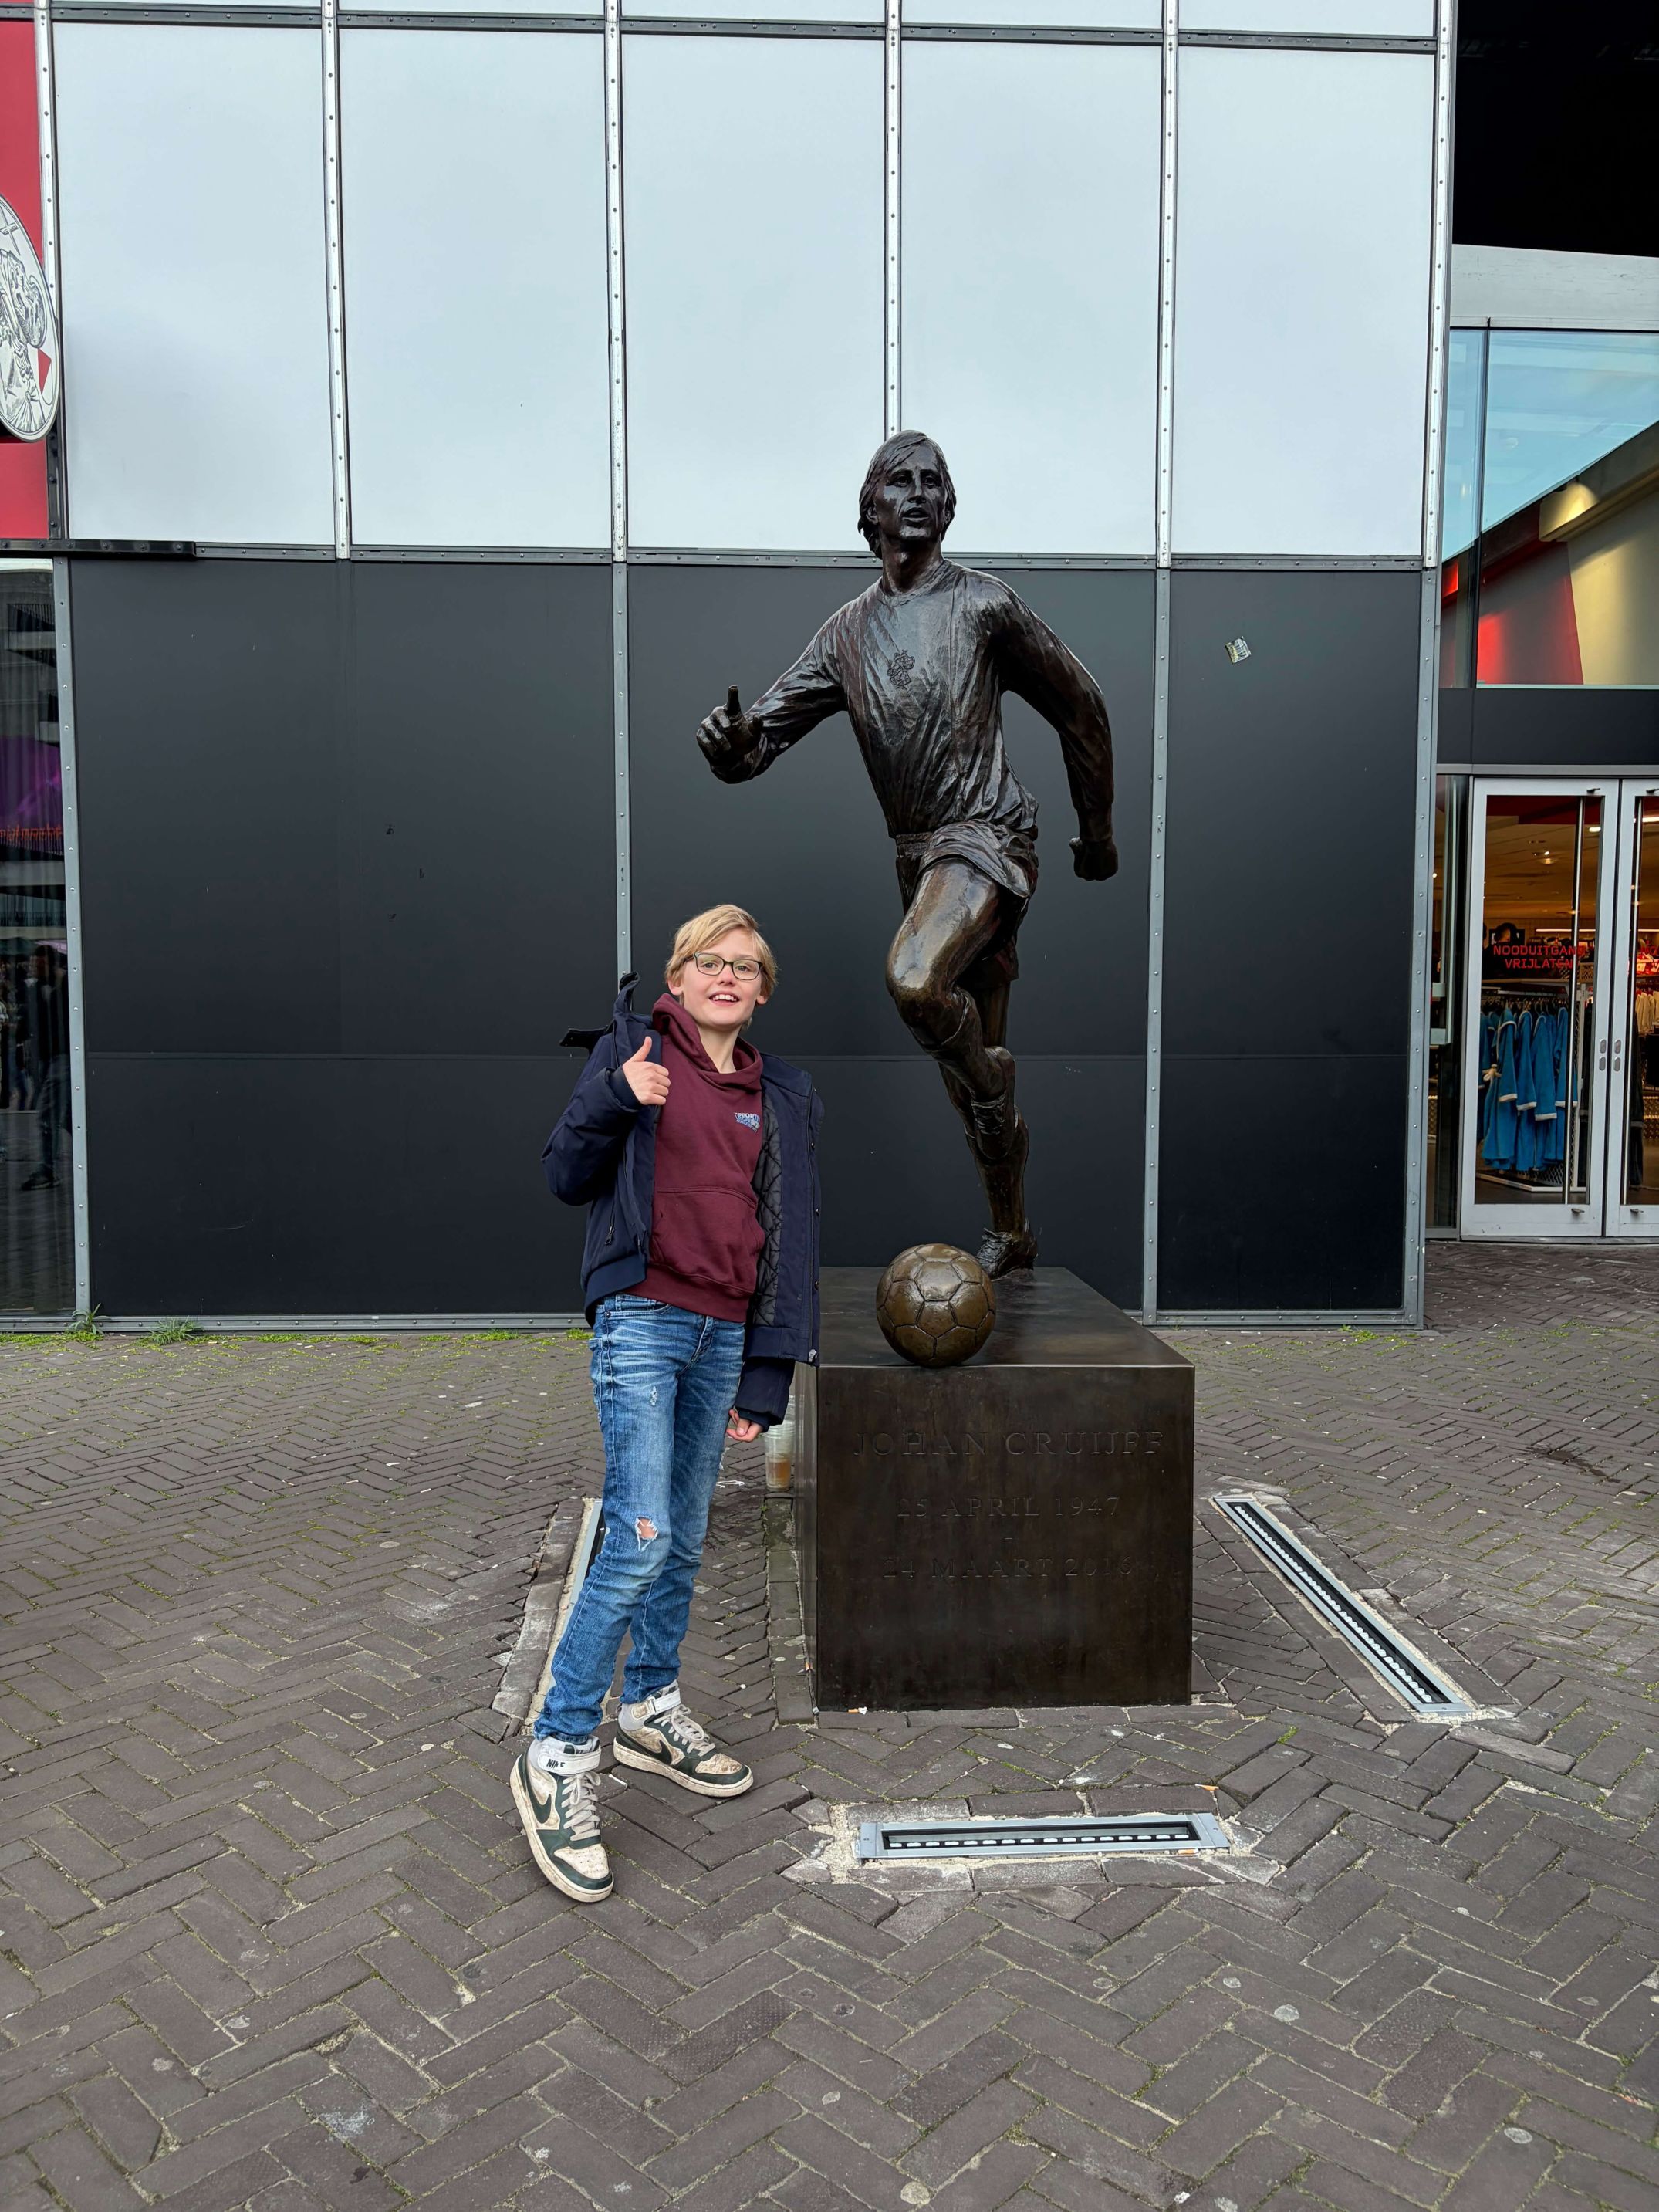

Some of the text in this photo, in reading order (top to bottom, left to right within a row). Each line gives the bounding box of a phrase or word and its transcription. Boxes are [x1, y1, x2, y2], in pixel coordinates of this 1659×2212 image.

[1505, 958, 1573, 969] VRIJLATEN
[852, 1431, 1165, 1456] JOHAN CRUIJFF
[896, 1496, 1121, 1518] 25 APRIL 1947
[882, 1556, 1134, 1578] 24 MAART 2016
